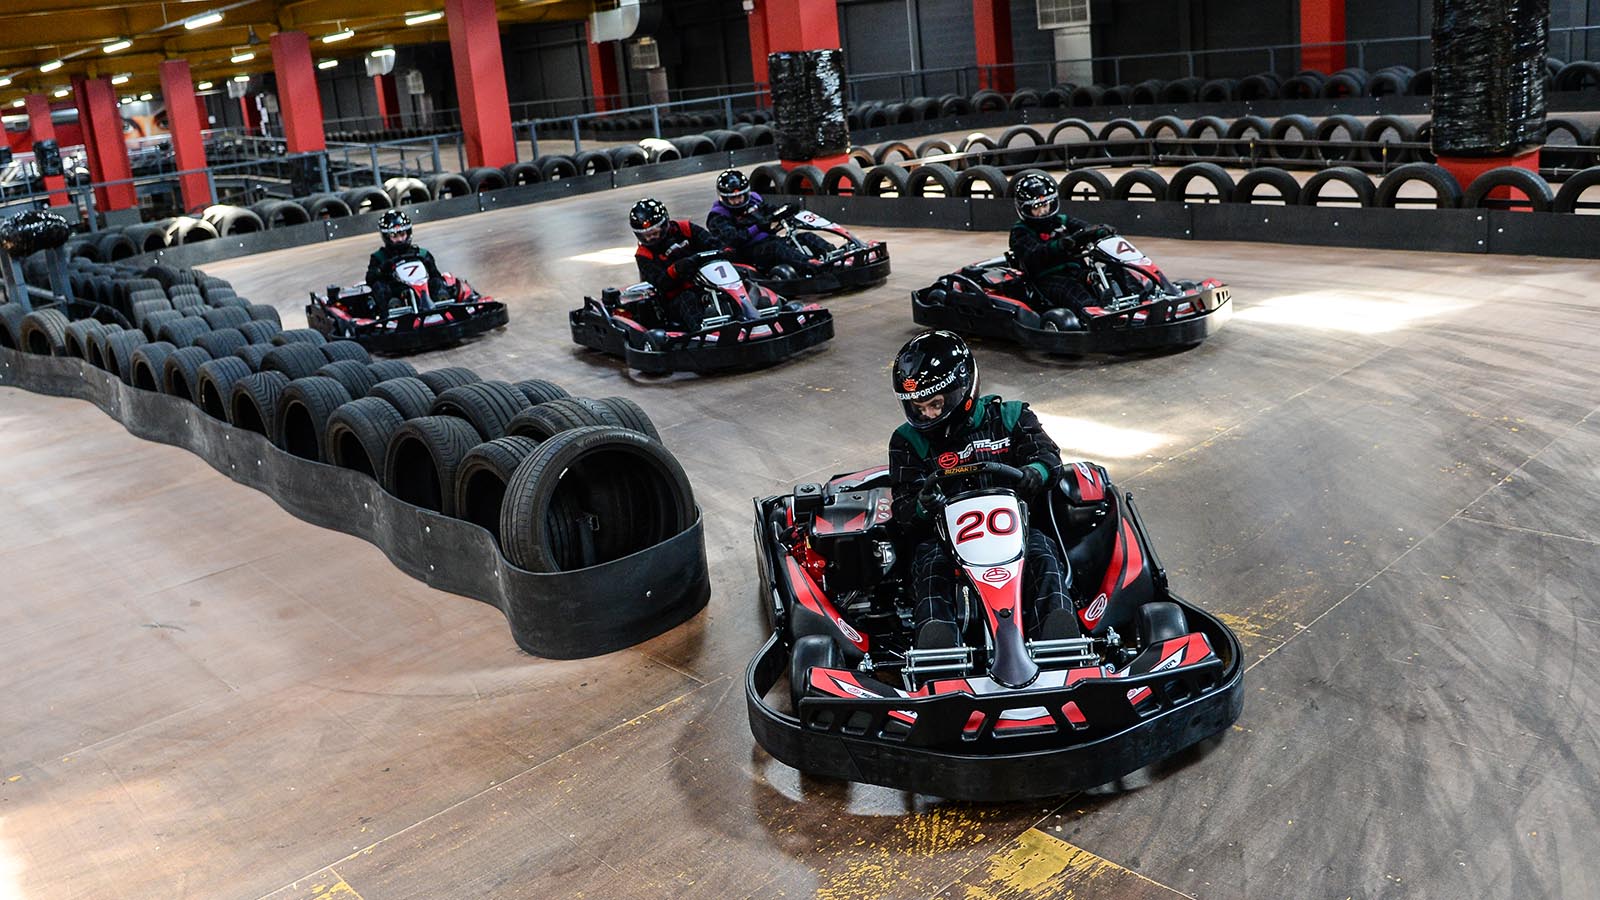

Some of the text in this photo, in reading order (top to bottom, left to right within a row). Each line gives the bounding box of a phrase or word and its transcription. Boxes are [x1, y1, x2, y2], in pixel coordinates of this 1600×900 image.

[1116, 241, 1136, 255] 4
[403, 265, 419, 277] 7
[714, 265, 727, 279] 1
[956, 507, 1019, 546] 20
